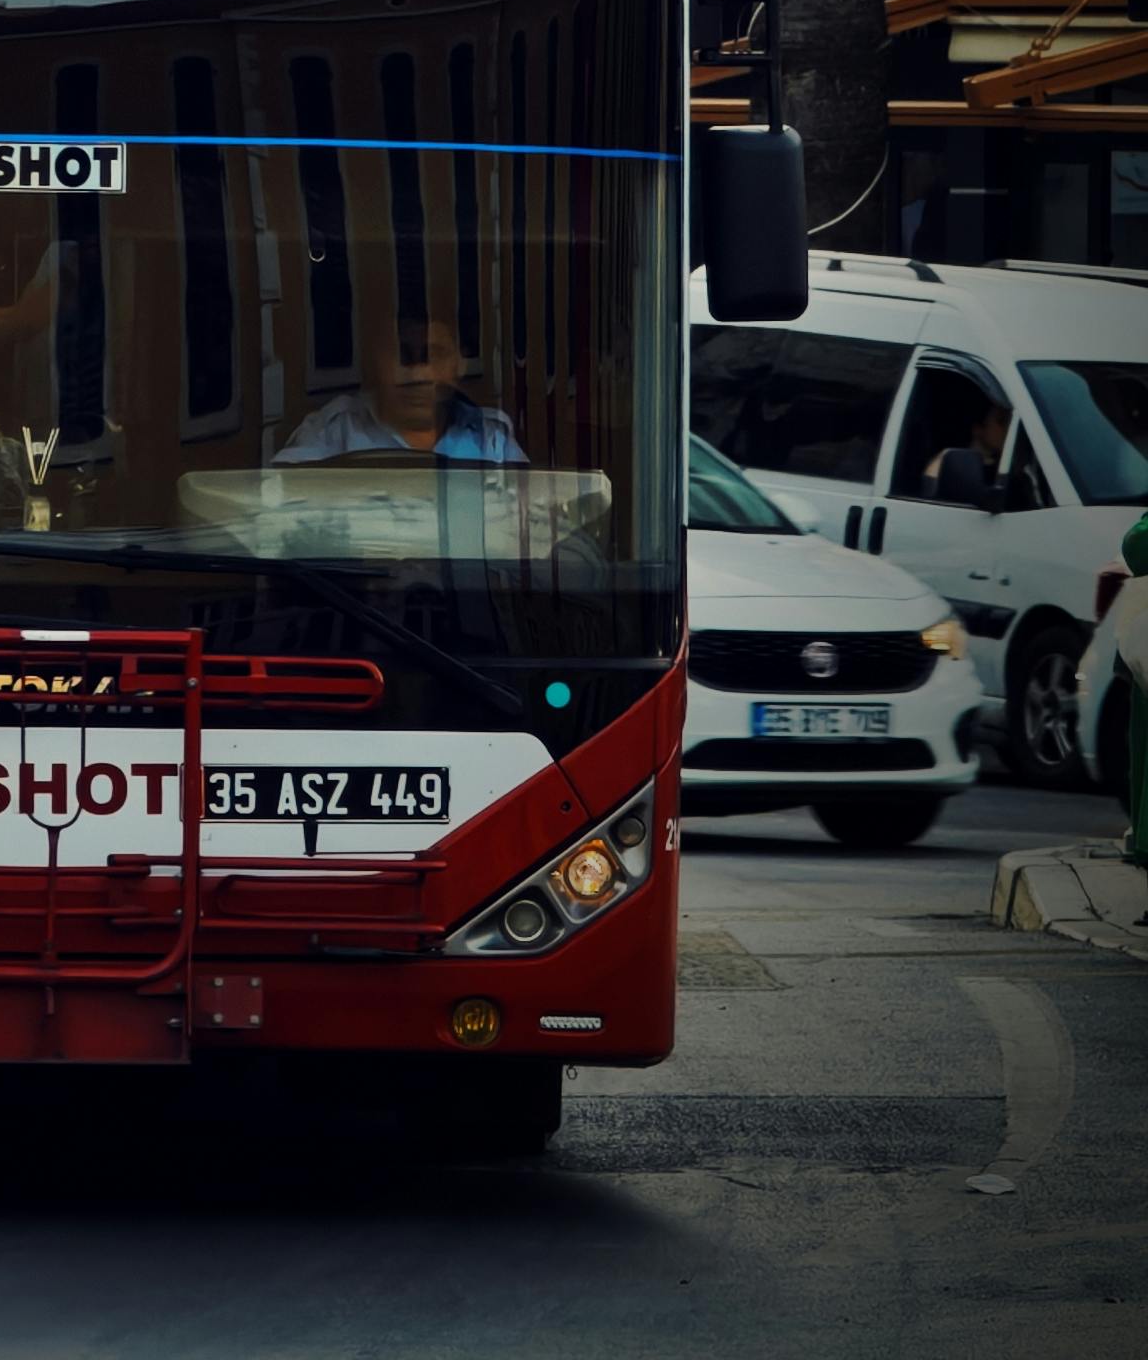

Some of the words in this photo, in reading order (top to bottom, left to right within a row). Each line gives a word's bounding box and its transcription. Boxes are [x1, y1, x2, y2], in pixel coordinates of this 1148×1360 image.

[208, 772, 257, 815] 35
[277, 772, 349, 816] ASZ
[370, 773, 443, 816] 449
